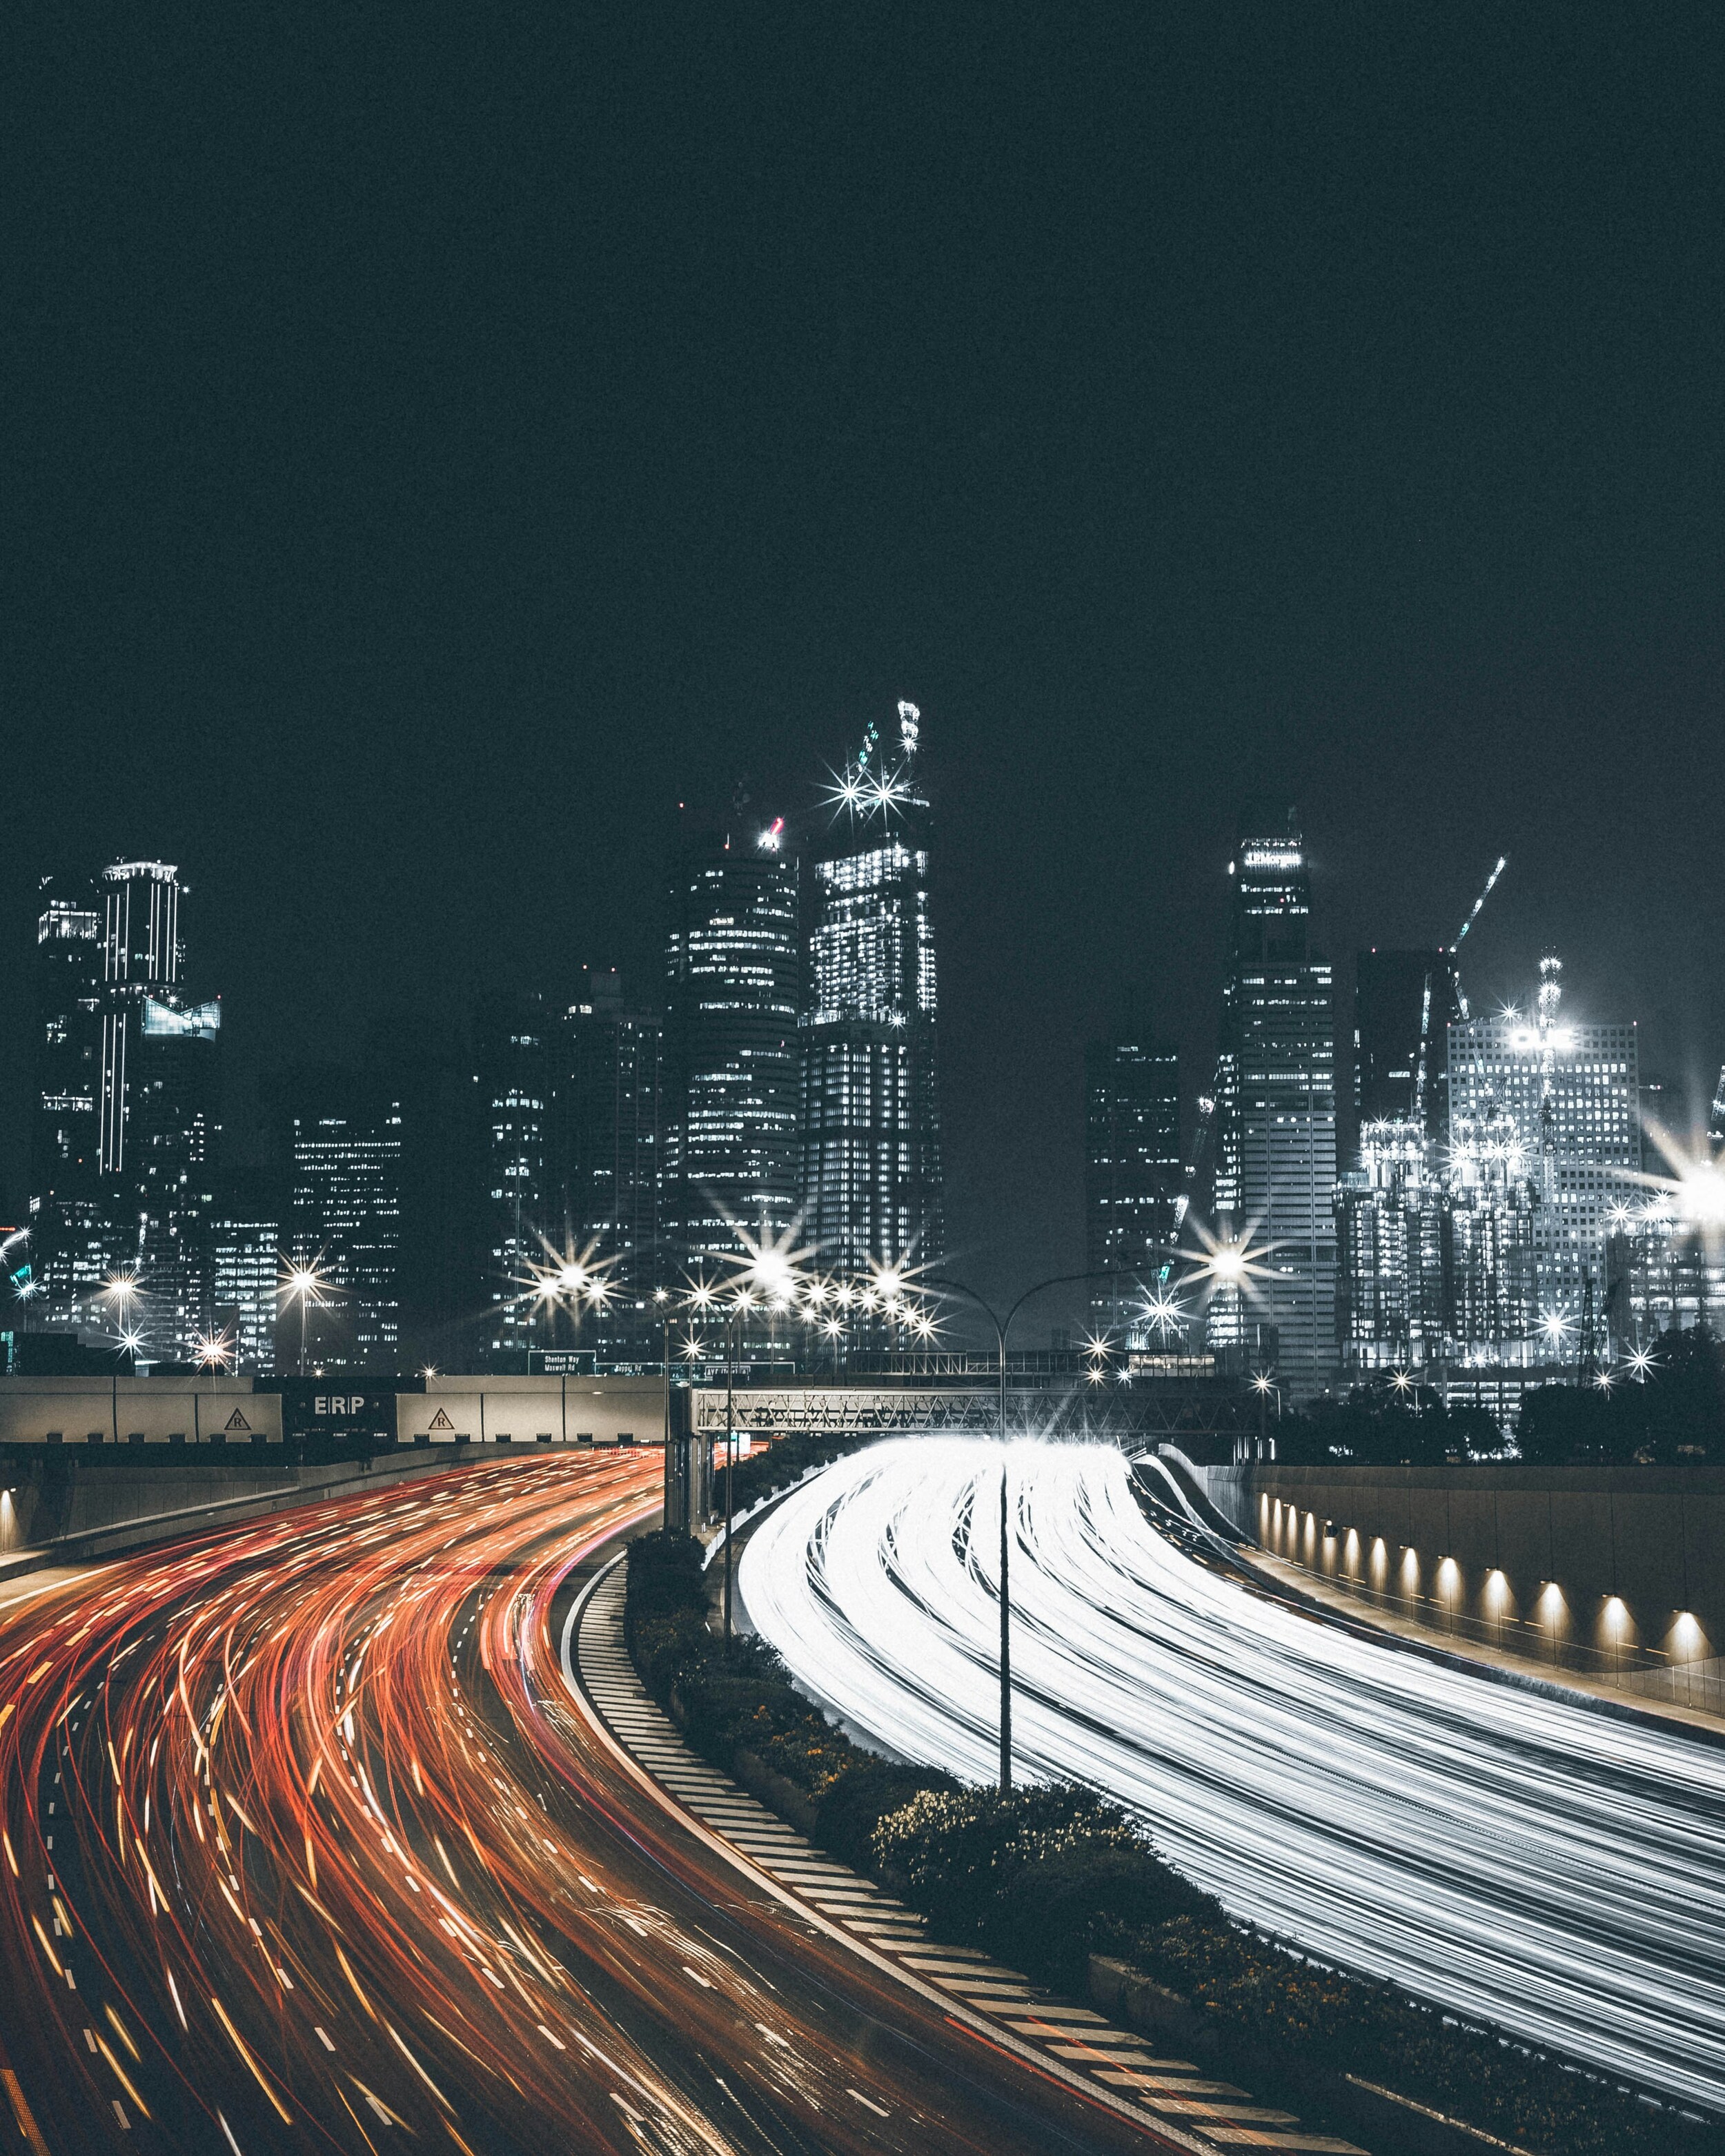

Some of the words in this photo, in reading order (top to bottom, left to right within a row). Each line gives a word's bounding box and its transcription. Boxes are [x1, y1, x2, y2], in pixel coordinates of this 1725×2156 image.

[545, 1355, 566, 1363] Shenton
[569, 1355, 580, 1365] Way
[568, 1363, 575, 1372] Rd
[315, 1396, 364, 1414] ERP
[234, 1418, 242, 1427] R
[437, 1417, 446, 1427] R
